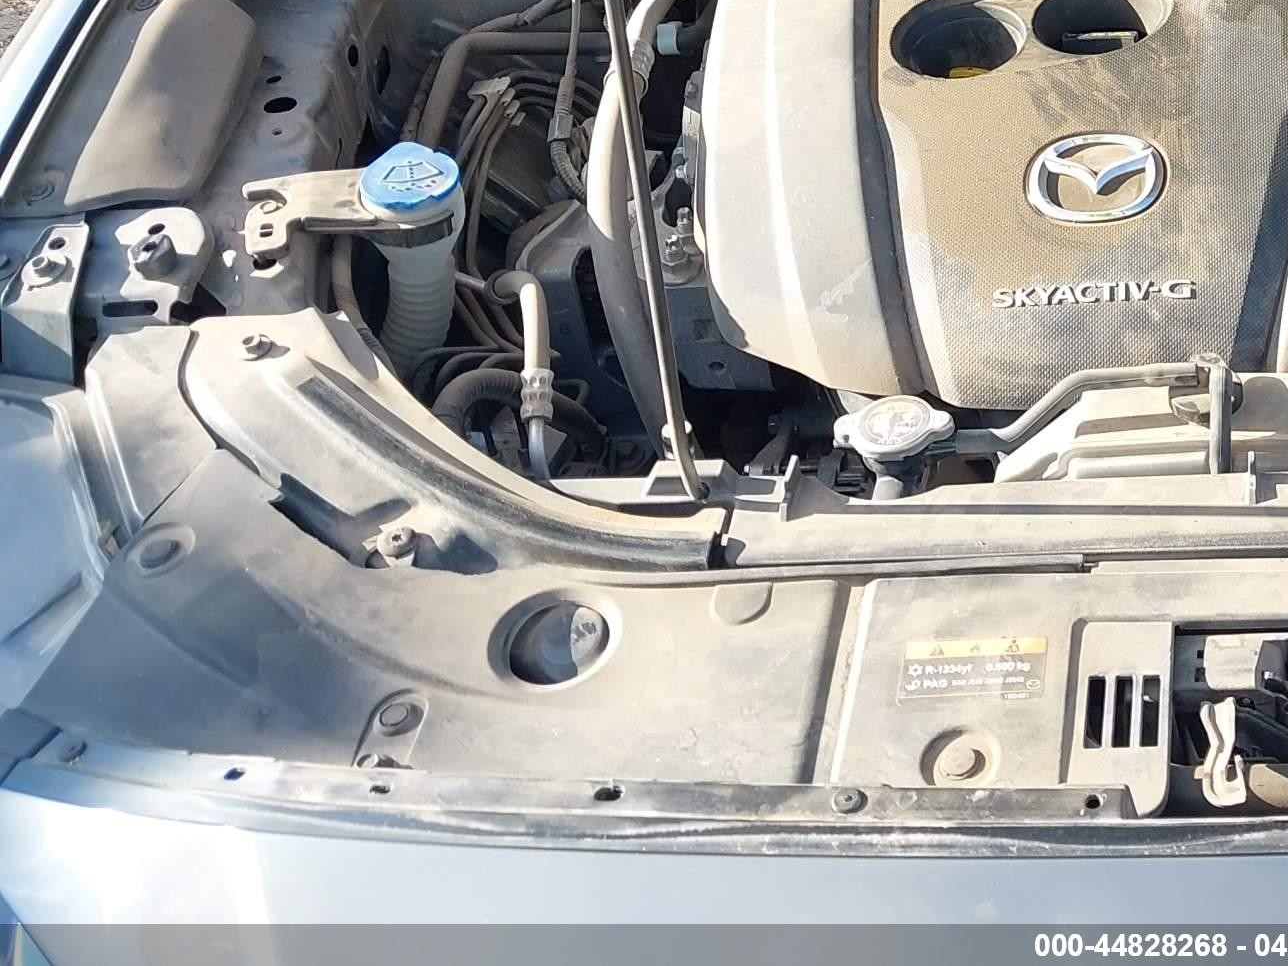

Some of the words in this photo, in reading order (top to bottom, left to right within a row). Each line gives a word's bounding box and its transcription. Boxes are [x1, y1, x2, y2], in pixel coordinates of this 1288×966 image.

[992, 279, 1197, 308] SKYACTIV-G
[925, 663, 974, 675] R-1234yf
[1016, 660, 1031, 673] kg
[923, 677, 948, 689] PAG
